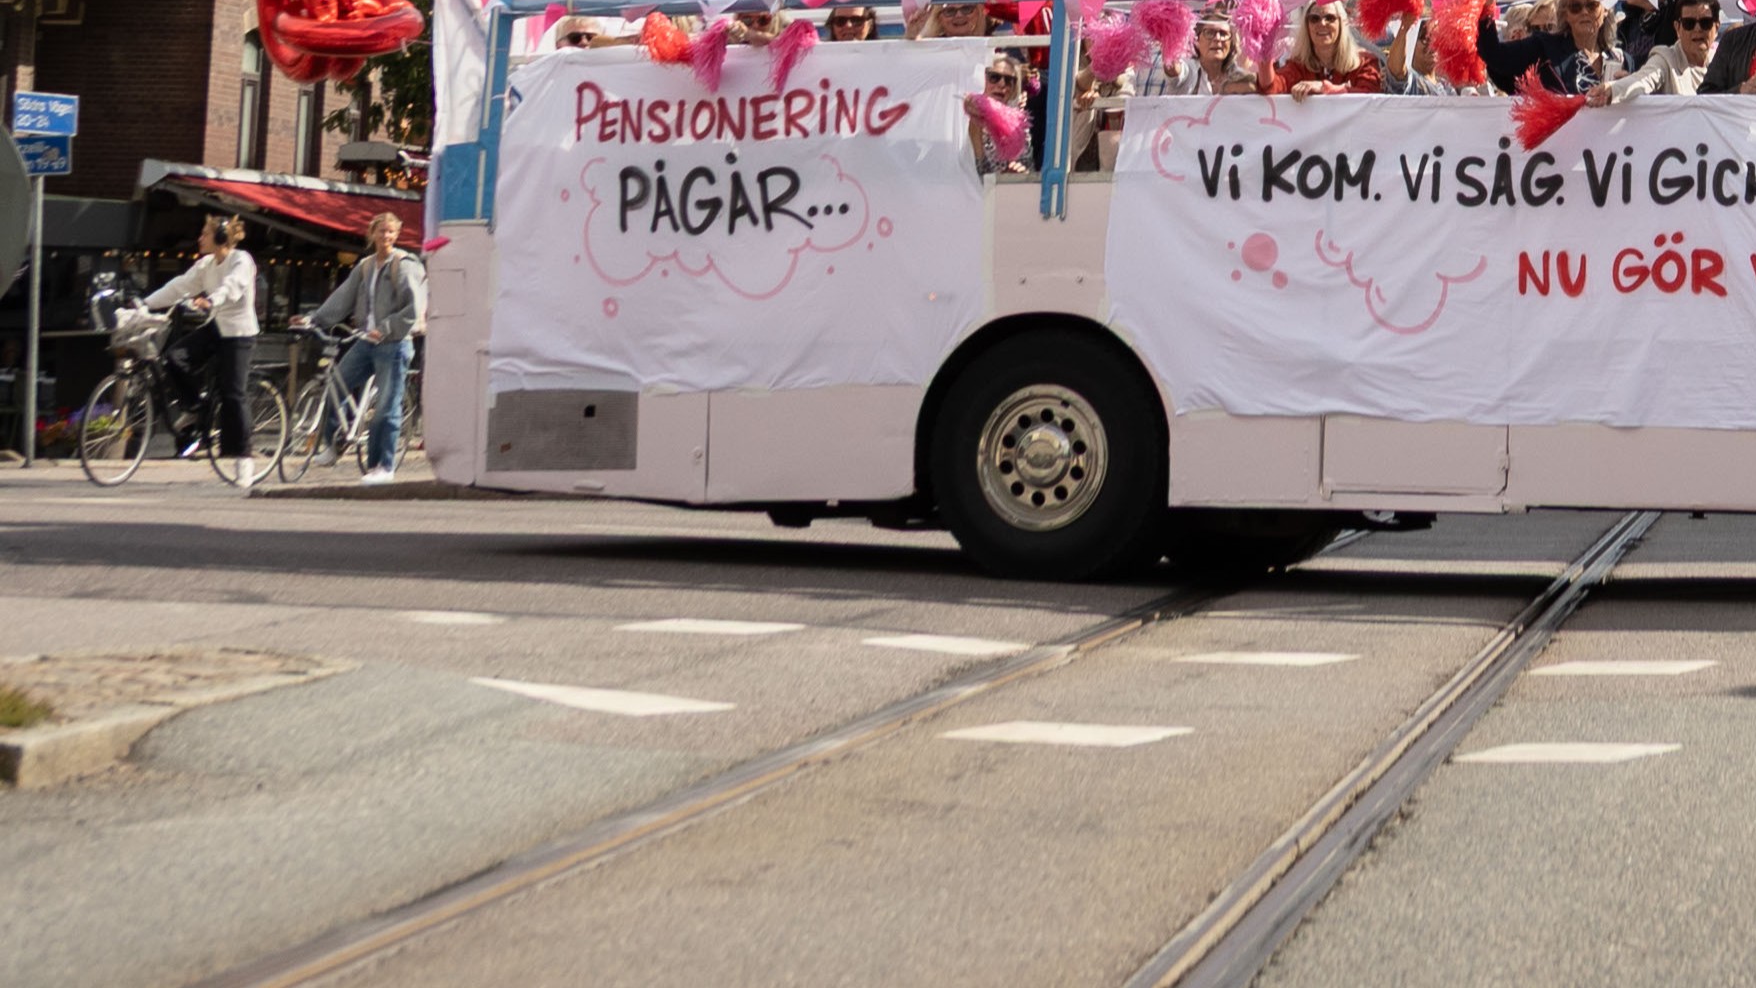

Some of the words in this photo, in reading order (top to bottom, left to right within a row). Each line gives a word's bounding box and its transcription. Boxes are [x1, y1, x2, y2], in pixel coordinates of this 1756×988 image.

[618, 152, 850, 236] PÅGÅR...
[1261, 145, 1382, 202] KOM.
[1456, 136, 1565, 207] SÅG.
[1518, 250, 1588, 298] NU
[1612, 231, 1729, 298] GÖR
